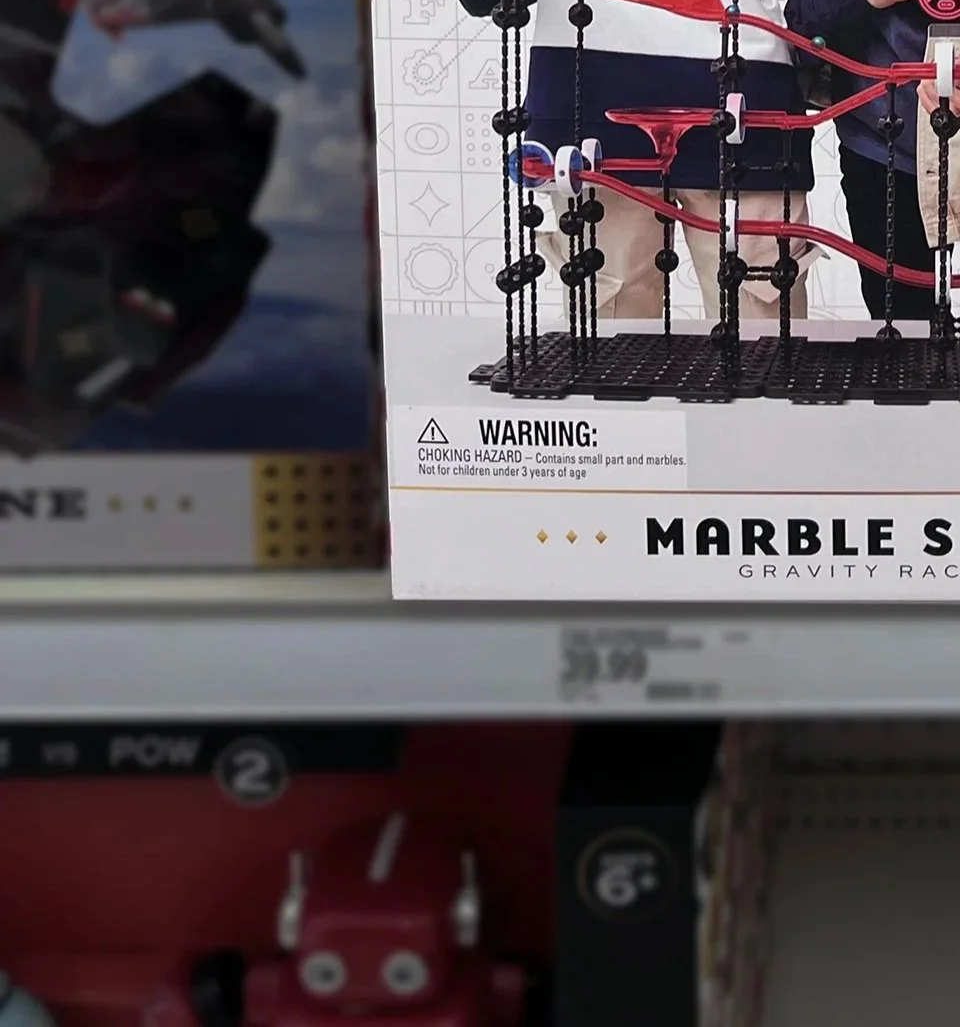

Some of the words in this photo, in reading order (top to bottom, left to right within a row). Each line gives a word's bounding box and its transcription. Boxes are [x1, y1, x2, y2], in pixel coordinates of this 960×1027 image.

[479, 419, 598, 447] WARNING:
[418, 448, 471, 462] CHOKING
[475, 450, 522, 463] HAZARD
[535, 452, 576, 465] Contains
[578, 453, 603, 465] small
[605, 454, 624, 468] part
[626, 453, 643, 465] and
[646, 454, 686, 466] marbles.
[418, 464, 435, 475] Not
[437, 464, 450, 476] for
[452, 464, 490, 476] children
[493, 465, 519, 477] under
[521, 466, 528, 477] 3
[529, 468, 556, 480] years
[558, 467, 567, 478] of
[569, 469, 587, 480] age
[647, 517, 895, 556] MARBLE
[738, 564, 879, 579] GRAVITY
[232, 748, 270, 792] 2
